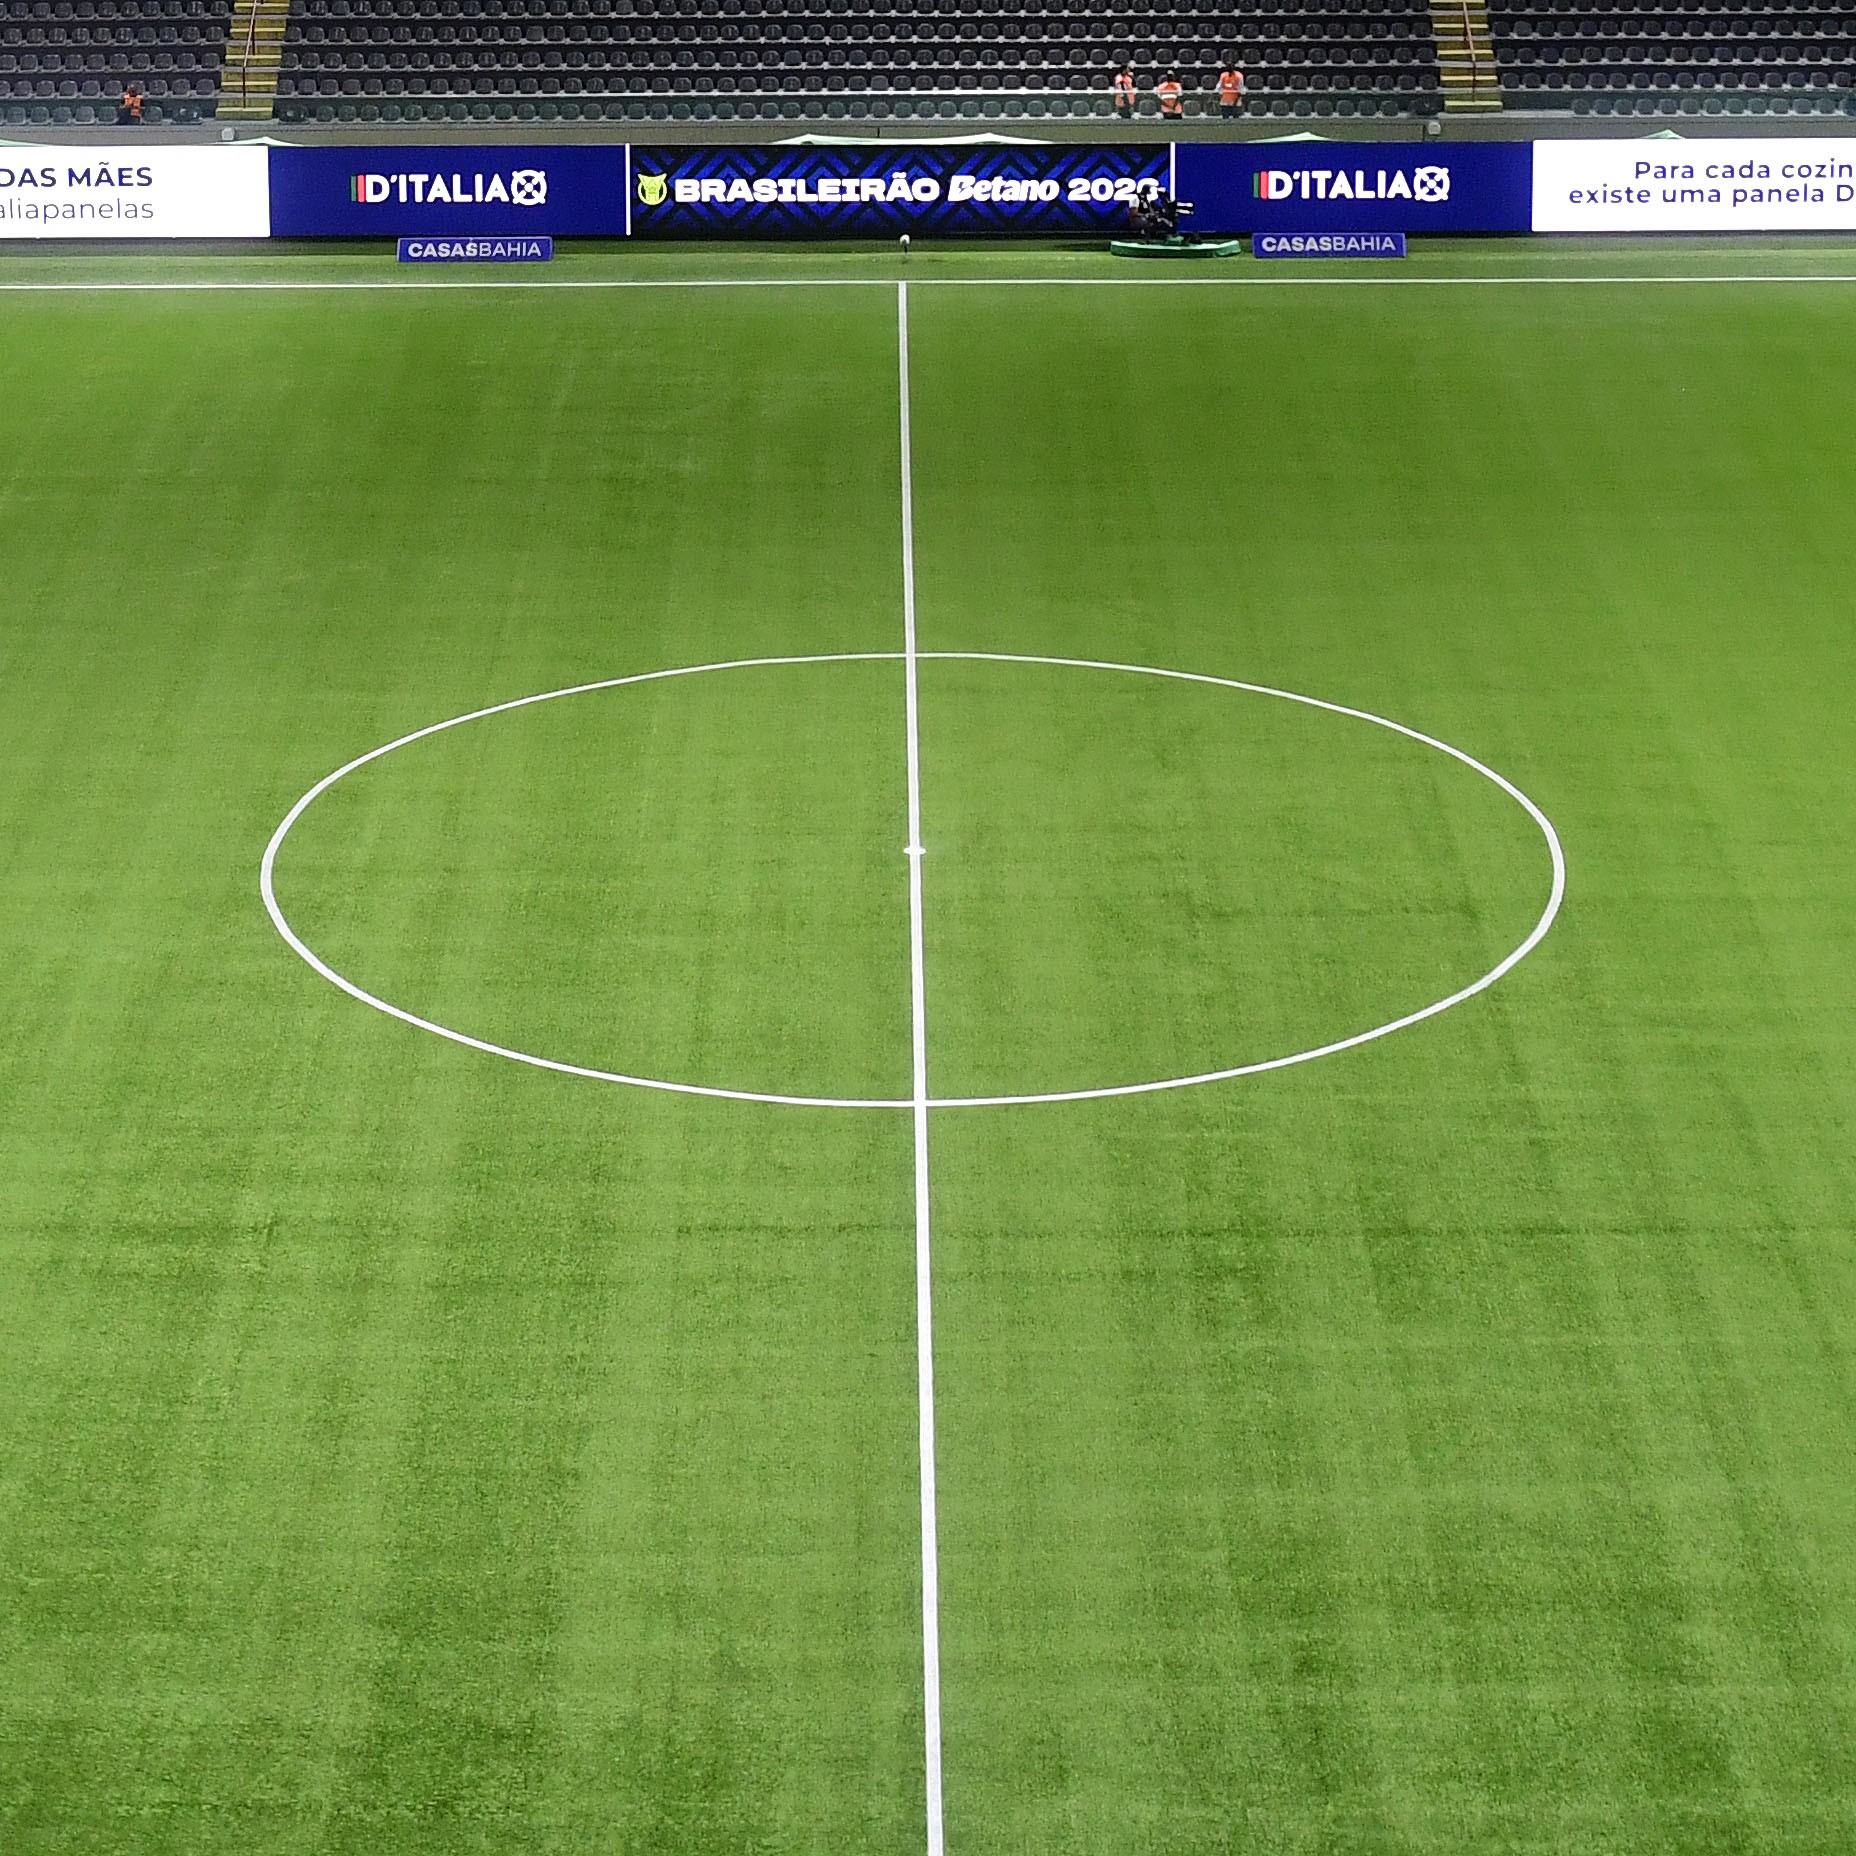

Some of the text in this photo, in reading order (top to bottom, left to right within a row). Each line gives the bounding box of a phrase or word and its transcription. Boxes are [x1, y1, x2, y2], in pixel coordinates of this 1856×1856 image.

[67, 161, 153, 188] MÃES
[1635, 161, 1695, 180] Para
[1706, 159, 1771, 179] cada
[365, 173, 510, 203] D'ITALIA
[675, 171, 940, 203] BRASILEIRÃO
[947, 174, 1060, 202] Betano
[1267, 169, 1413, 200] D'ITALIA
[1568, 182, 1651, 204] existe
[1662, 188, 1721, 204] uma
[1732, 182, 1825, 208] panela
